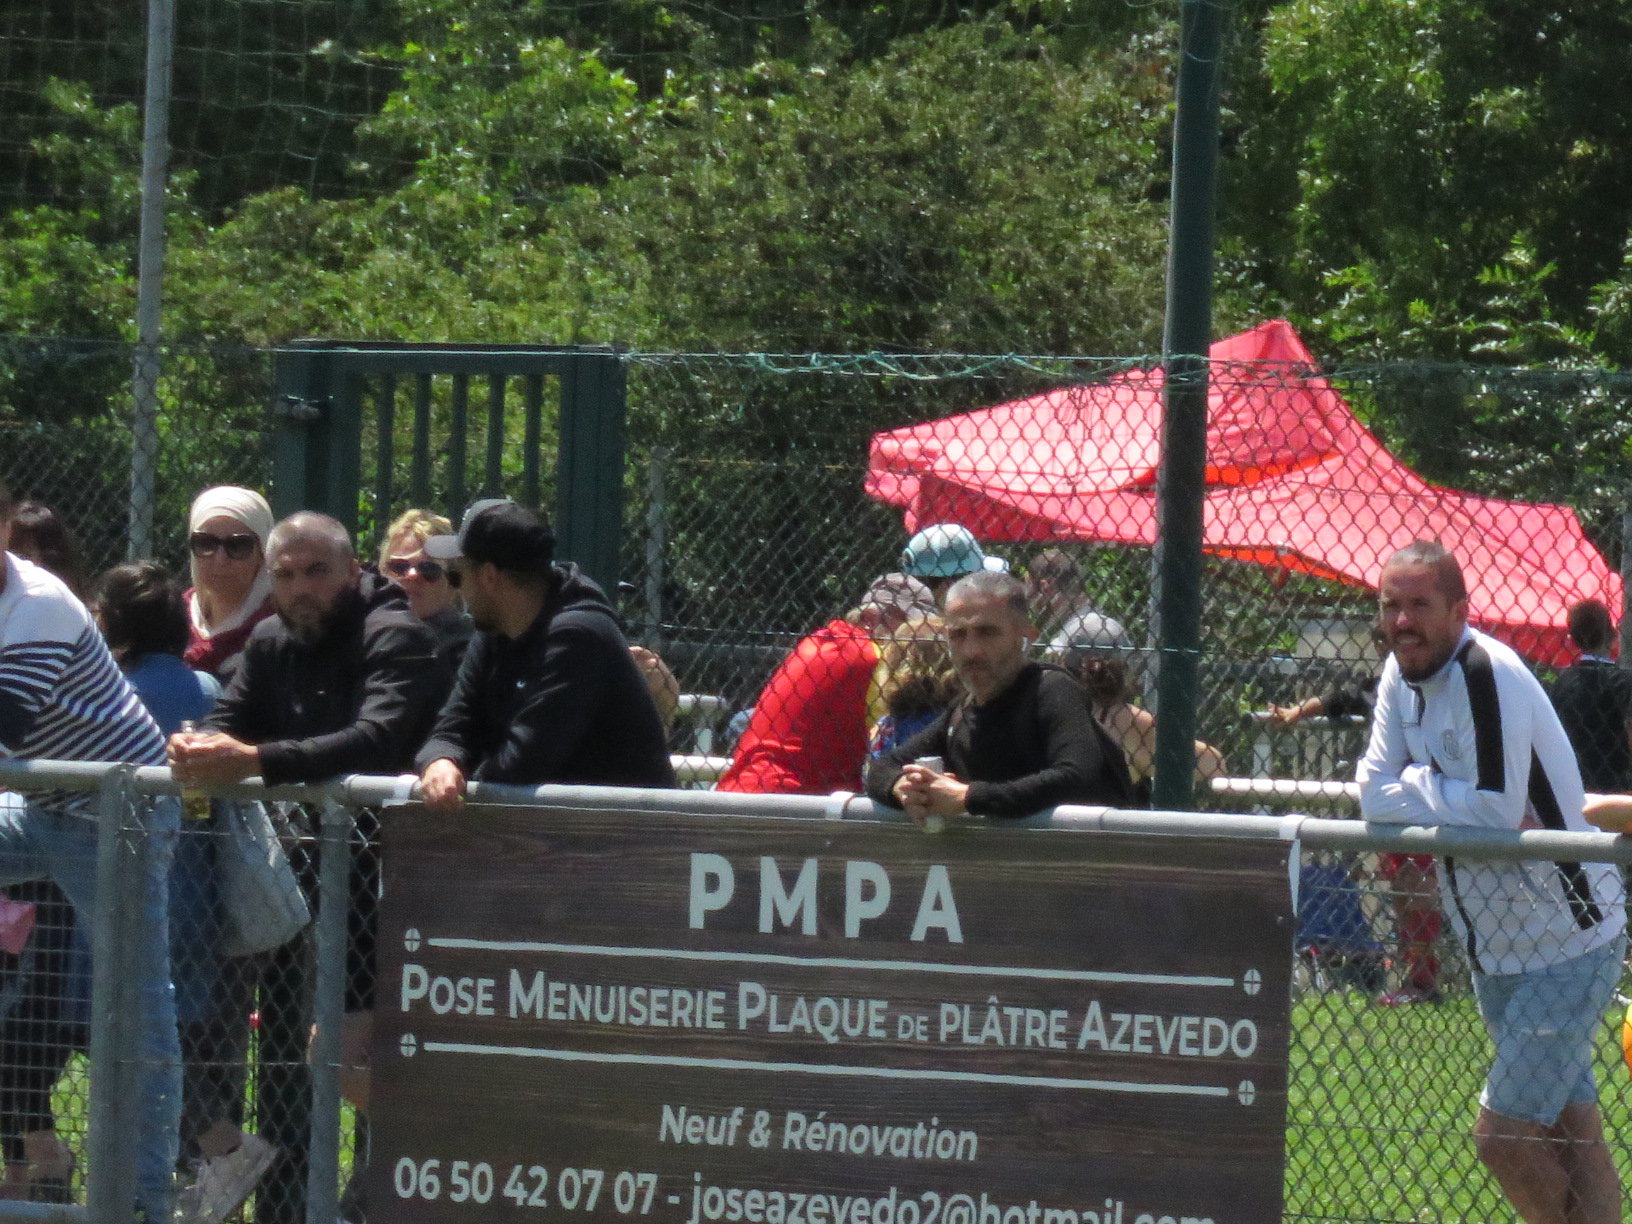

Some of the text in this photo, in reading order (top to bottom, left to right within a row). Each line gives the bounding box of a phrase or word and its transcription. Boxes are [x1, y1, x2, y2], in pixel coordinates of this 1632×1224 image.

[401, 963, 1258, 1059] POSE MENUISERIE PLAQUE DE PLÂTRE AZEVEDO
[659, 1104, 978, 1161] Neuf & Rénovation
[394, 1157, 440, 1200] 06
[449, 1161, 494, 1204] 50
[503, 1164, 549, 1207] 42
[558, 1167, 604, 1211] 07
[613, 1171, 658, 1215] 07
[668, 1195, 681, 1205] -
